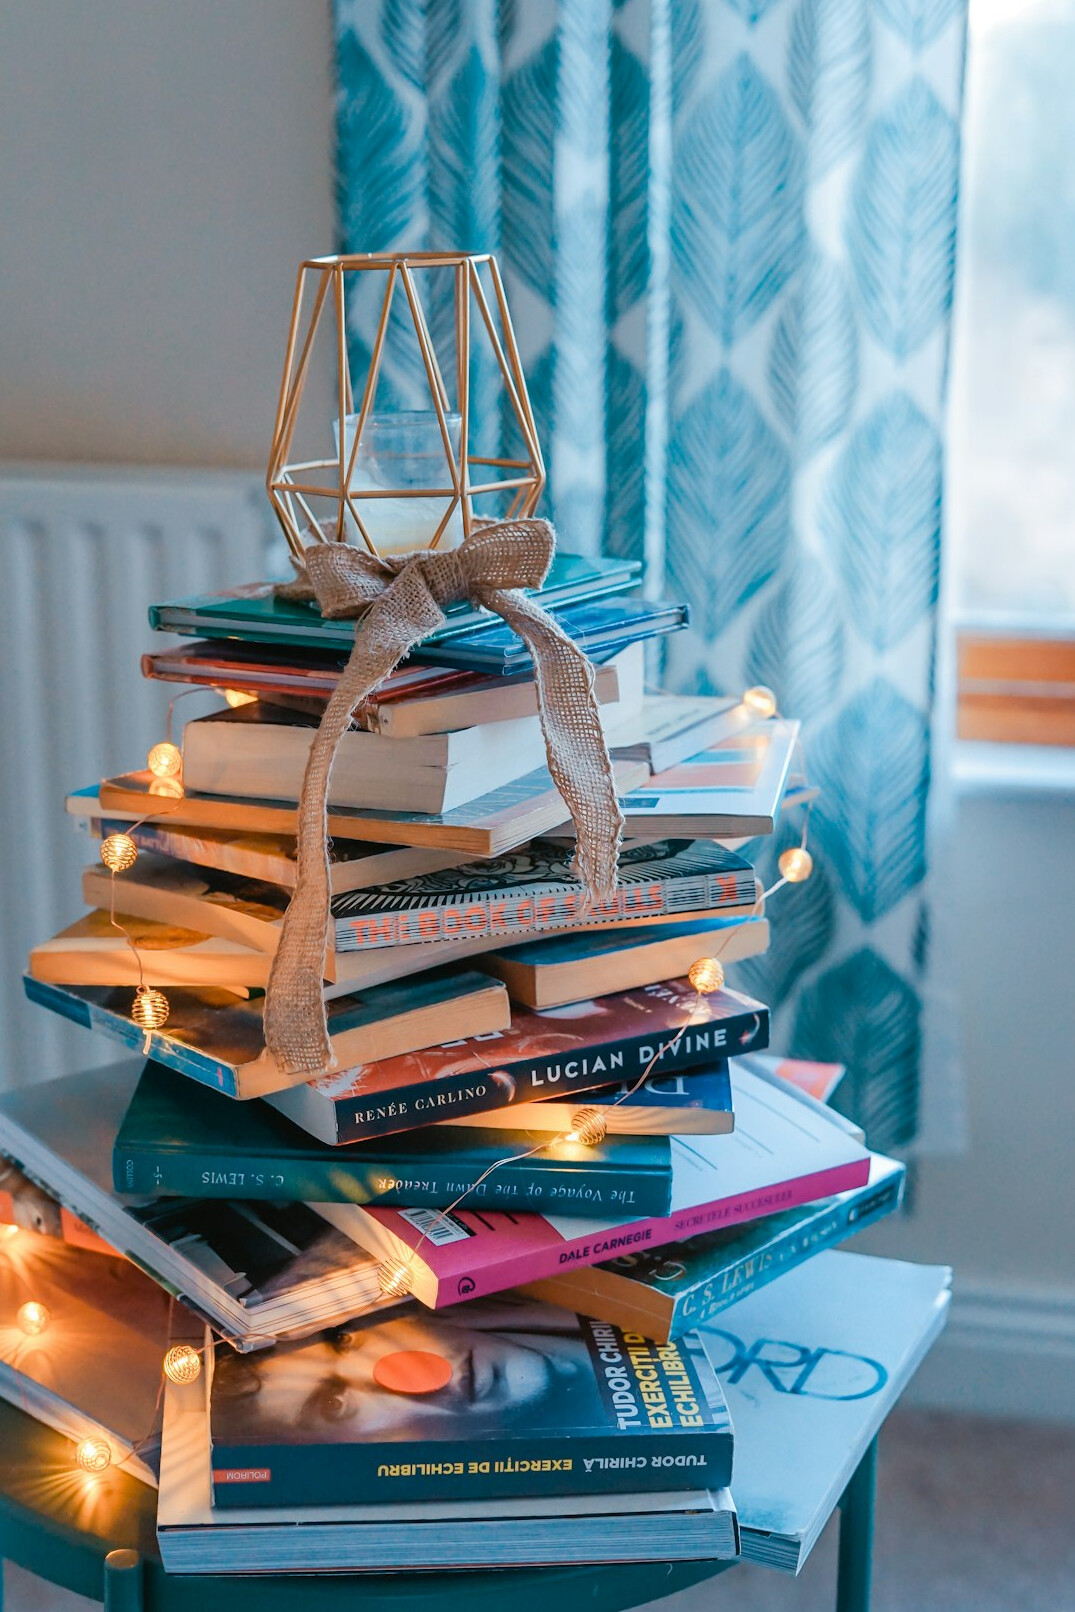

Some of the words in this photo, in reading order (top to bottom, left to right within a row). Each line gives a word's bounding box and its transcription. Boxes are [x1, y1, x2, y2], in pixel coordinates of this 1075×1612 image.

[350, 914, 411, 945] THE
[418, 903, 509, 937] BOOK
[517, 898, 556, 926] OF
[531, 1051, 624, 1086] LUCIAN
[639, 1029, 727, 1064] DIVINE
[354, 1101, 408, 1124] RENÉE
[414, 1085, 487, 1110] CARLINO
[201, 1171, 245, 1185] LEWIS
[250, 1173, 264, 1186] S.
[270, 1174, 284, 1187] C.
[445, 1181, 487, 1196] Dawn
[495, 1184, 517, 1196] the
[527, 1185, 542, 1199] of
[550, 1187, 602, 1202] Voyage
[610, 1190, 635, 1203] The
[559, 1246, 590, 1264] DALE
[593, 1228, 653, 1254] CARNEGIE
[682, 1292, 698, 1317] C.
[703, 1283, 716, 1306] S.
[721, 1253, 773, 1295] LEWIS
[604, 1366, 641, 1430] TUDOR
[468, 1461, 490, 1474] DE
[582, 1456, 648, 1473] CHIRILĂ
[650, 1454, 708, 1468] TUDOR
[226, 1471, 267, 1480] POLIROM
[377, 1462, 465, 1477] ECHILIBRU
